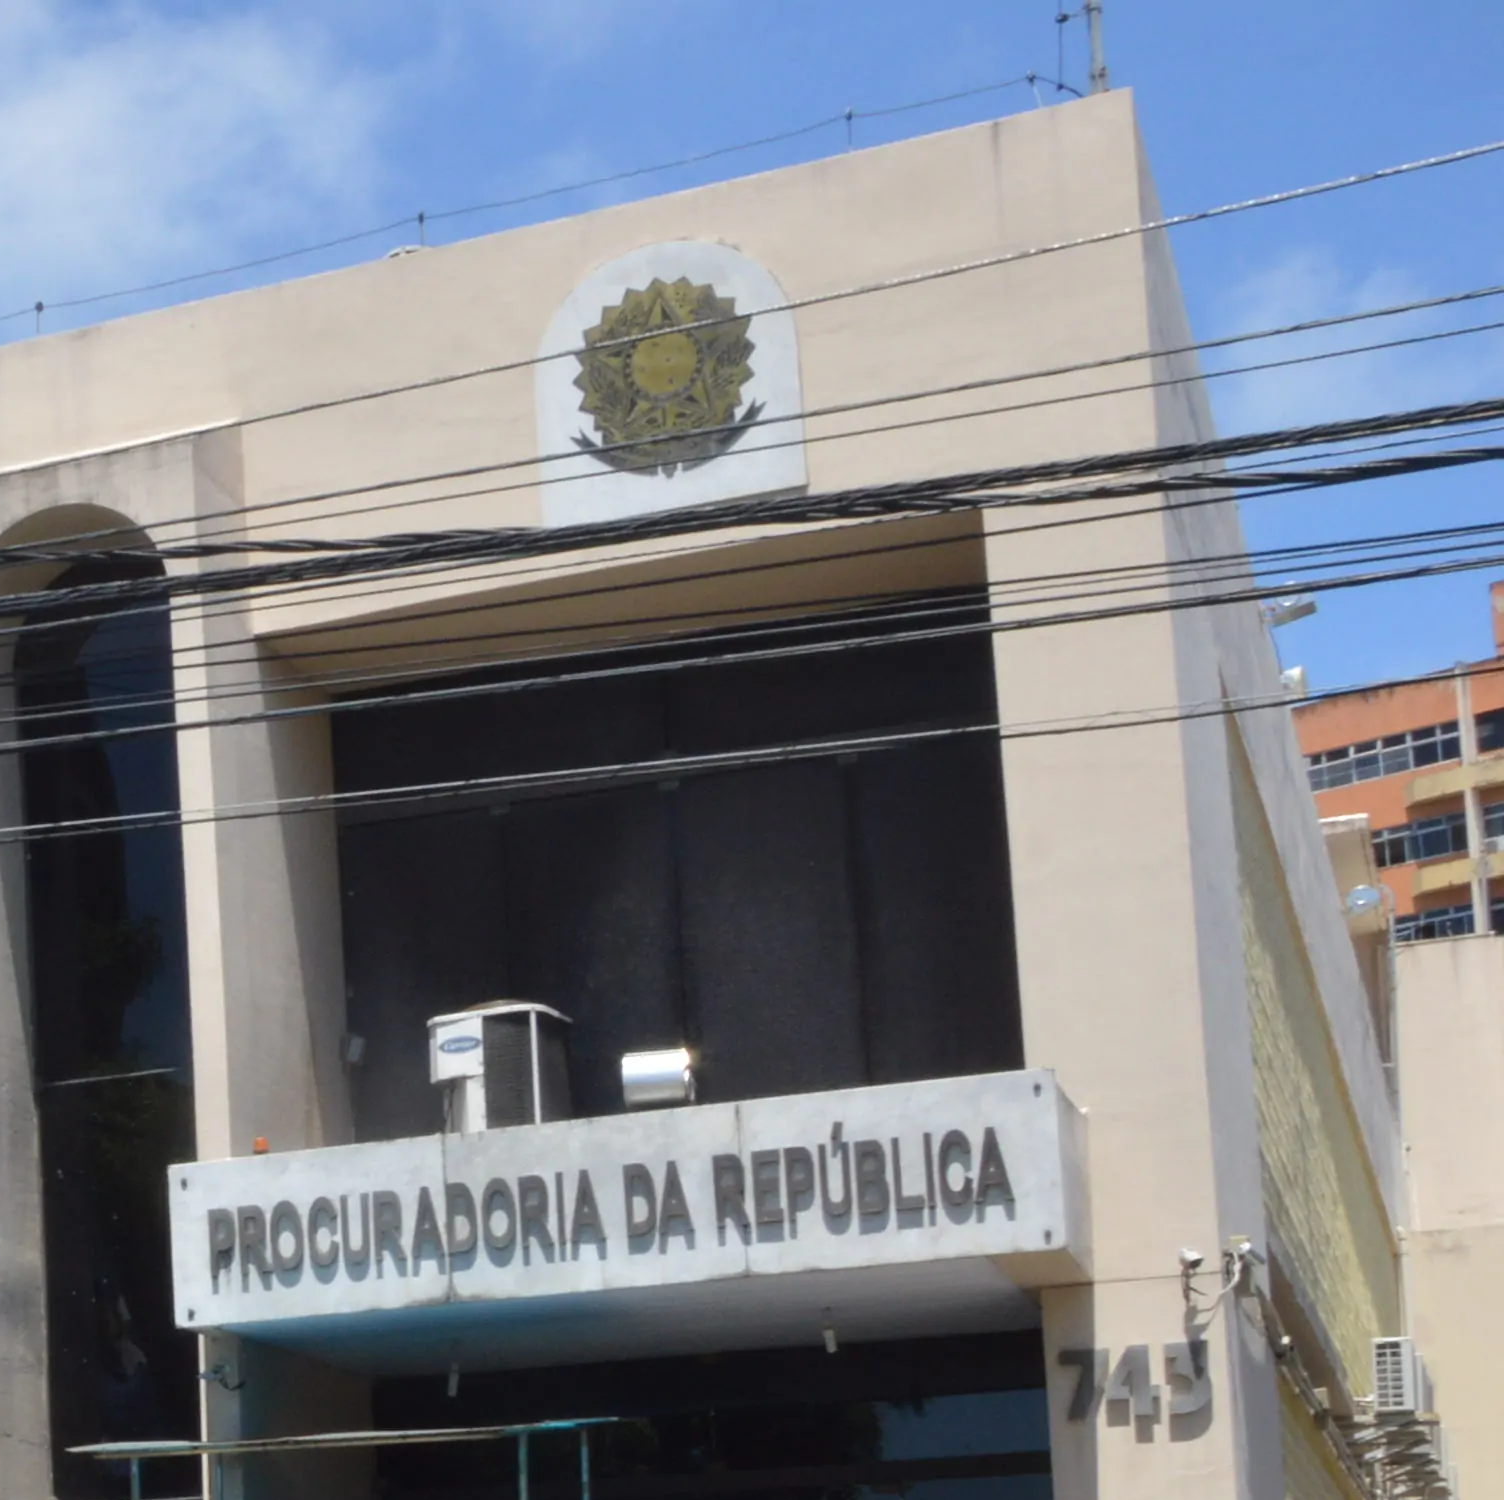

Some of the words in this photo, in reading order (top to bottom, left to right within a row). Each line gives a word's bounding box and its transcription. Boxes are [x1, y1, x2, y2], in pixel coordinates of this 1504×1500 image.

[206, 1168, 607, 1282] PROCURADORIA
[622, 1160, 695, 1240] DA
[711, 1121, 1016, 1230] REPÚBLICA
